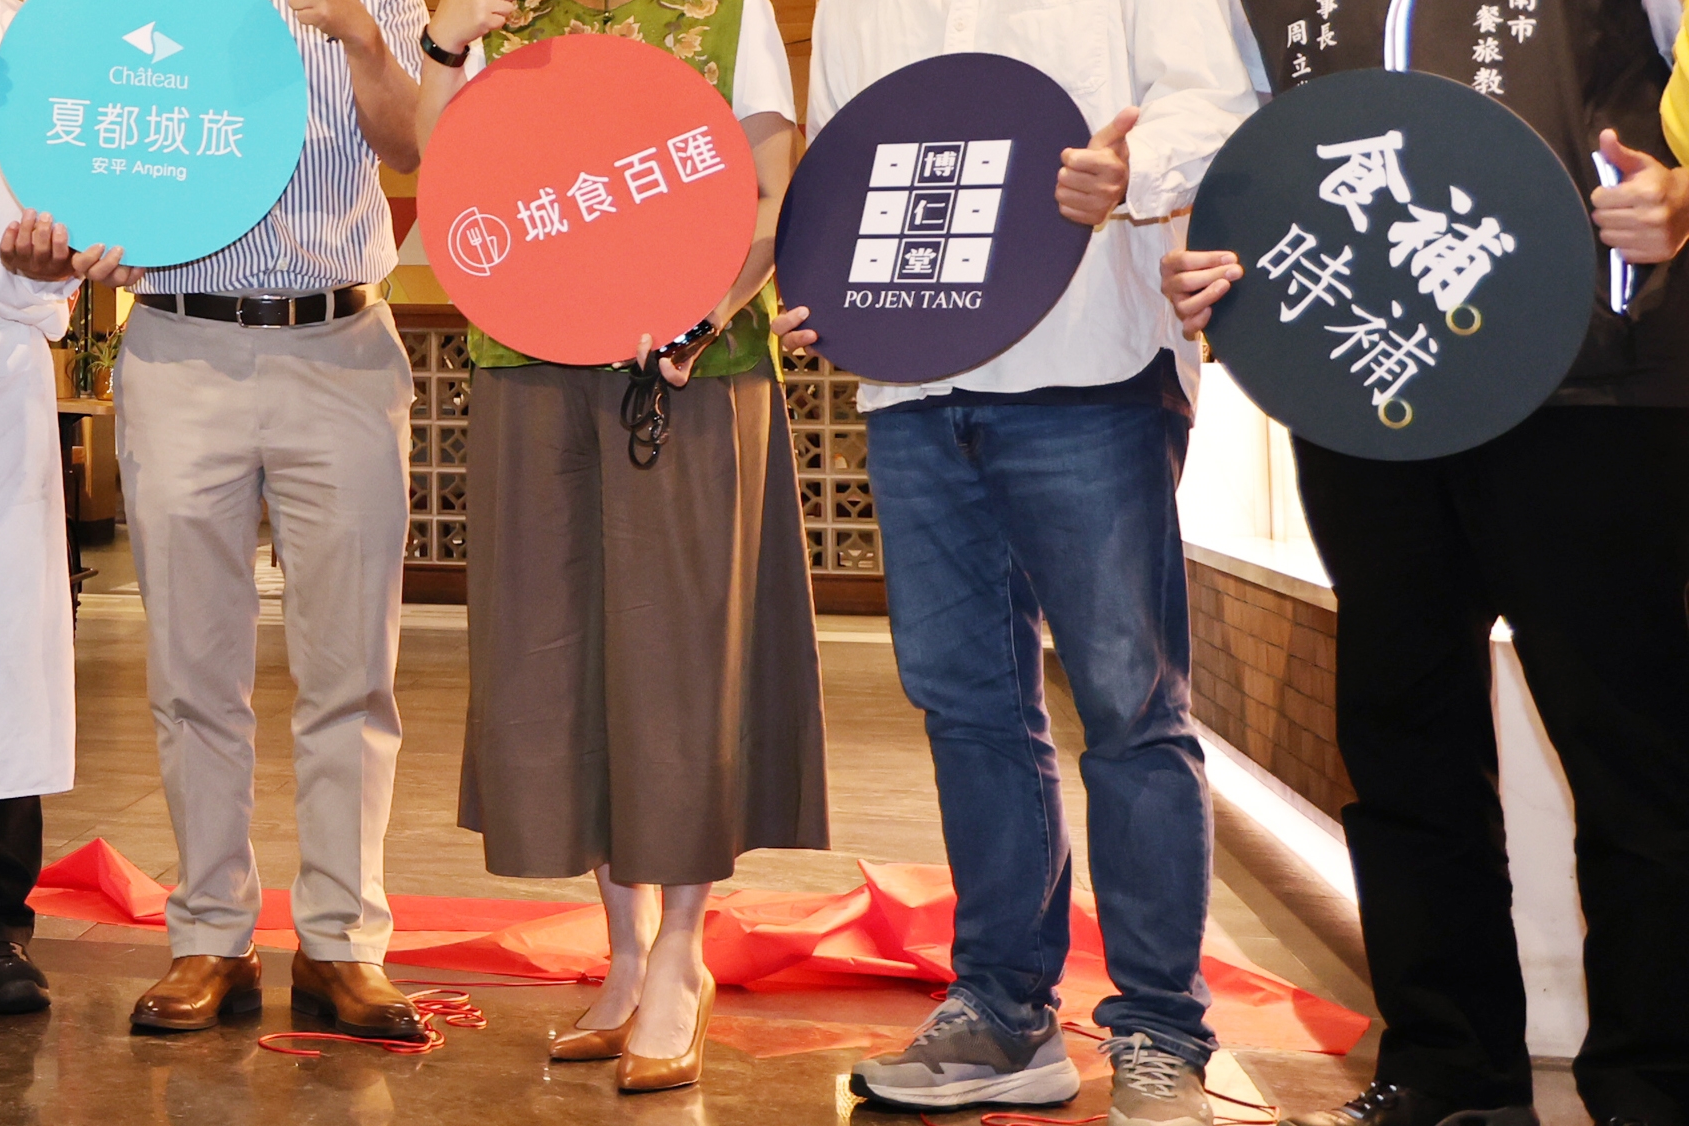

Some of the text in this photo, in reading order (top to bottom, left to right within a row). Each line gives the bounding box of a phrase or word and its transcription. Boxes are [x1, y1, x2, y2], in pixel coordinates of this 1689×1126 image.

[109, 66, 188, 90] Château
[1287, 19, 1311, 86] 周立
[1472, 4, 1505, 95] 餐旅教
[45, 97, 245, 158] 夏都城旅
[91, 156, 188, 181] 安平 Anping
[517, 125, 726, 242] 城食百匯
[901, 150, 958, 274] 博仁堂
[843, 290, 982, 309] PO JEN TANG
[1256, 222, 1439, 406] 時補
